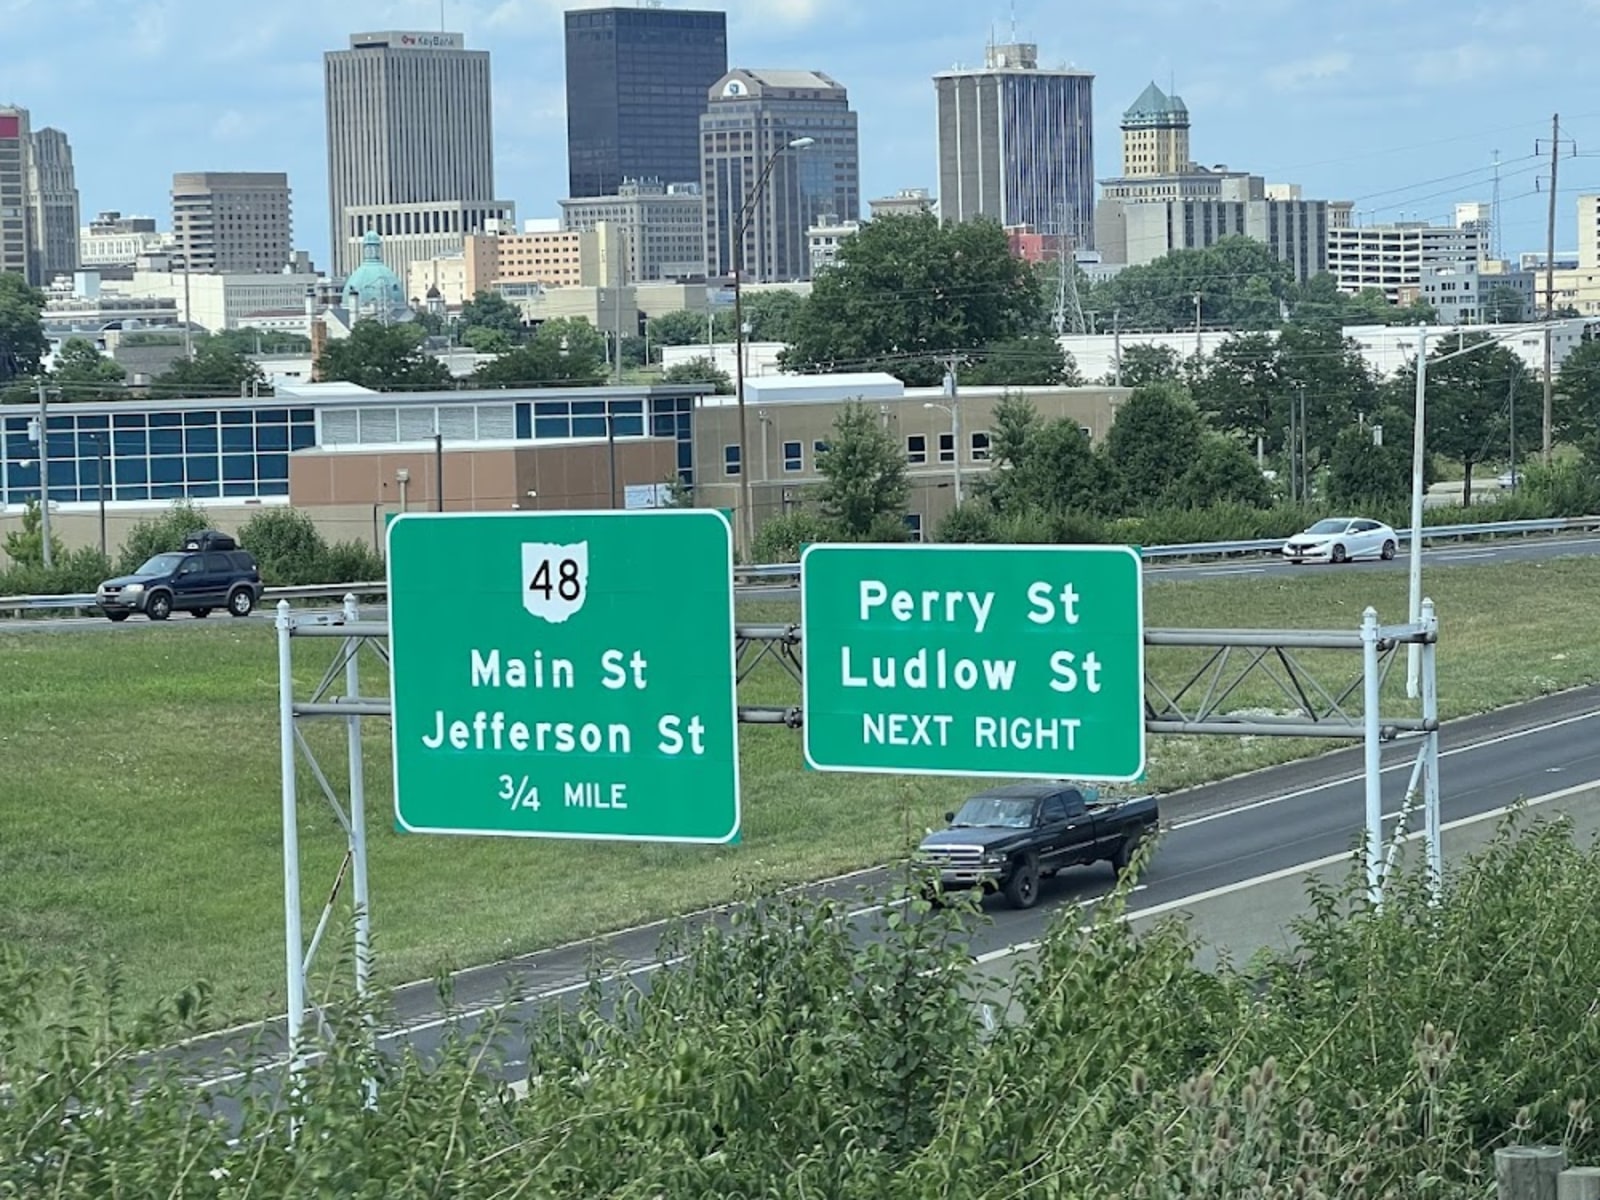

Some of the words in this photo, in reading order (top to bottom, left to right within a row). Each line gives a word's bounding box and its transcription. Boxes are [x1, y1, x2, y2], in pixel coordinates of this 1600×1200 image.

[418, 35, 454, 48] KeyBank
[529, 559, 580, 601] 48
[860, 580, 995, 633] Perry
[1027, 581, 1079, 624] St
[471, 649, 574, 688] Main
[601, 649, 647, 689] St
[842, 646, 1017, 690] Ludlow
[1050, 650, 1101, 693] St
[422, 711, 630, 753] Jefferson
[658, 714, 705, 755] St
[863, 713, 953, 746] NEXT
[975, 716, 1081, 750] RIGHT
[564, 782, 627, 809] MILE
